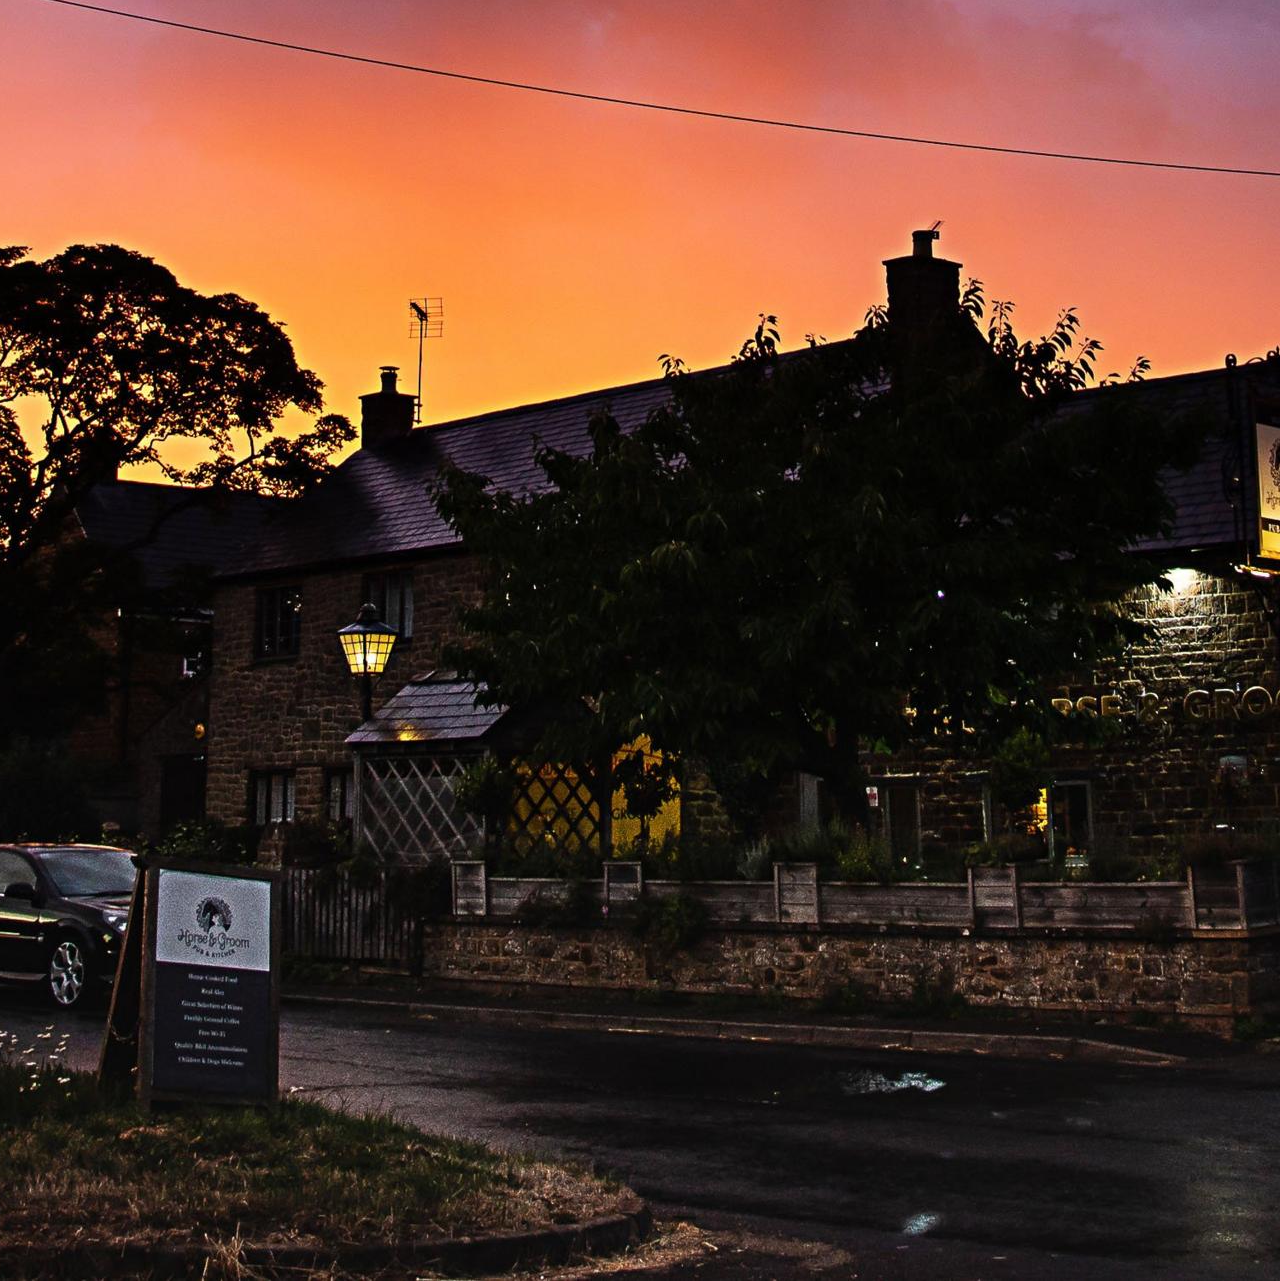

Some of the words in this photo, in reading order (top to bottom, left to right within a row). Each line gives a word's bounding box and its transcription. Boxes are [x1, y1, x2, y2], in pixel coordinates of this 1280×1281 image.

[1268, 523, 1280, 533] PUB
[1139, 692, 1167, 722] &
[177, 929, 208, 946] Horse
[209, 932, 217, 947] &
[217, 932, 250, 950] Groom
[192, 945, 204, 954] PUB
[211, 949, 236, 958] KITCHEN
